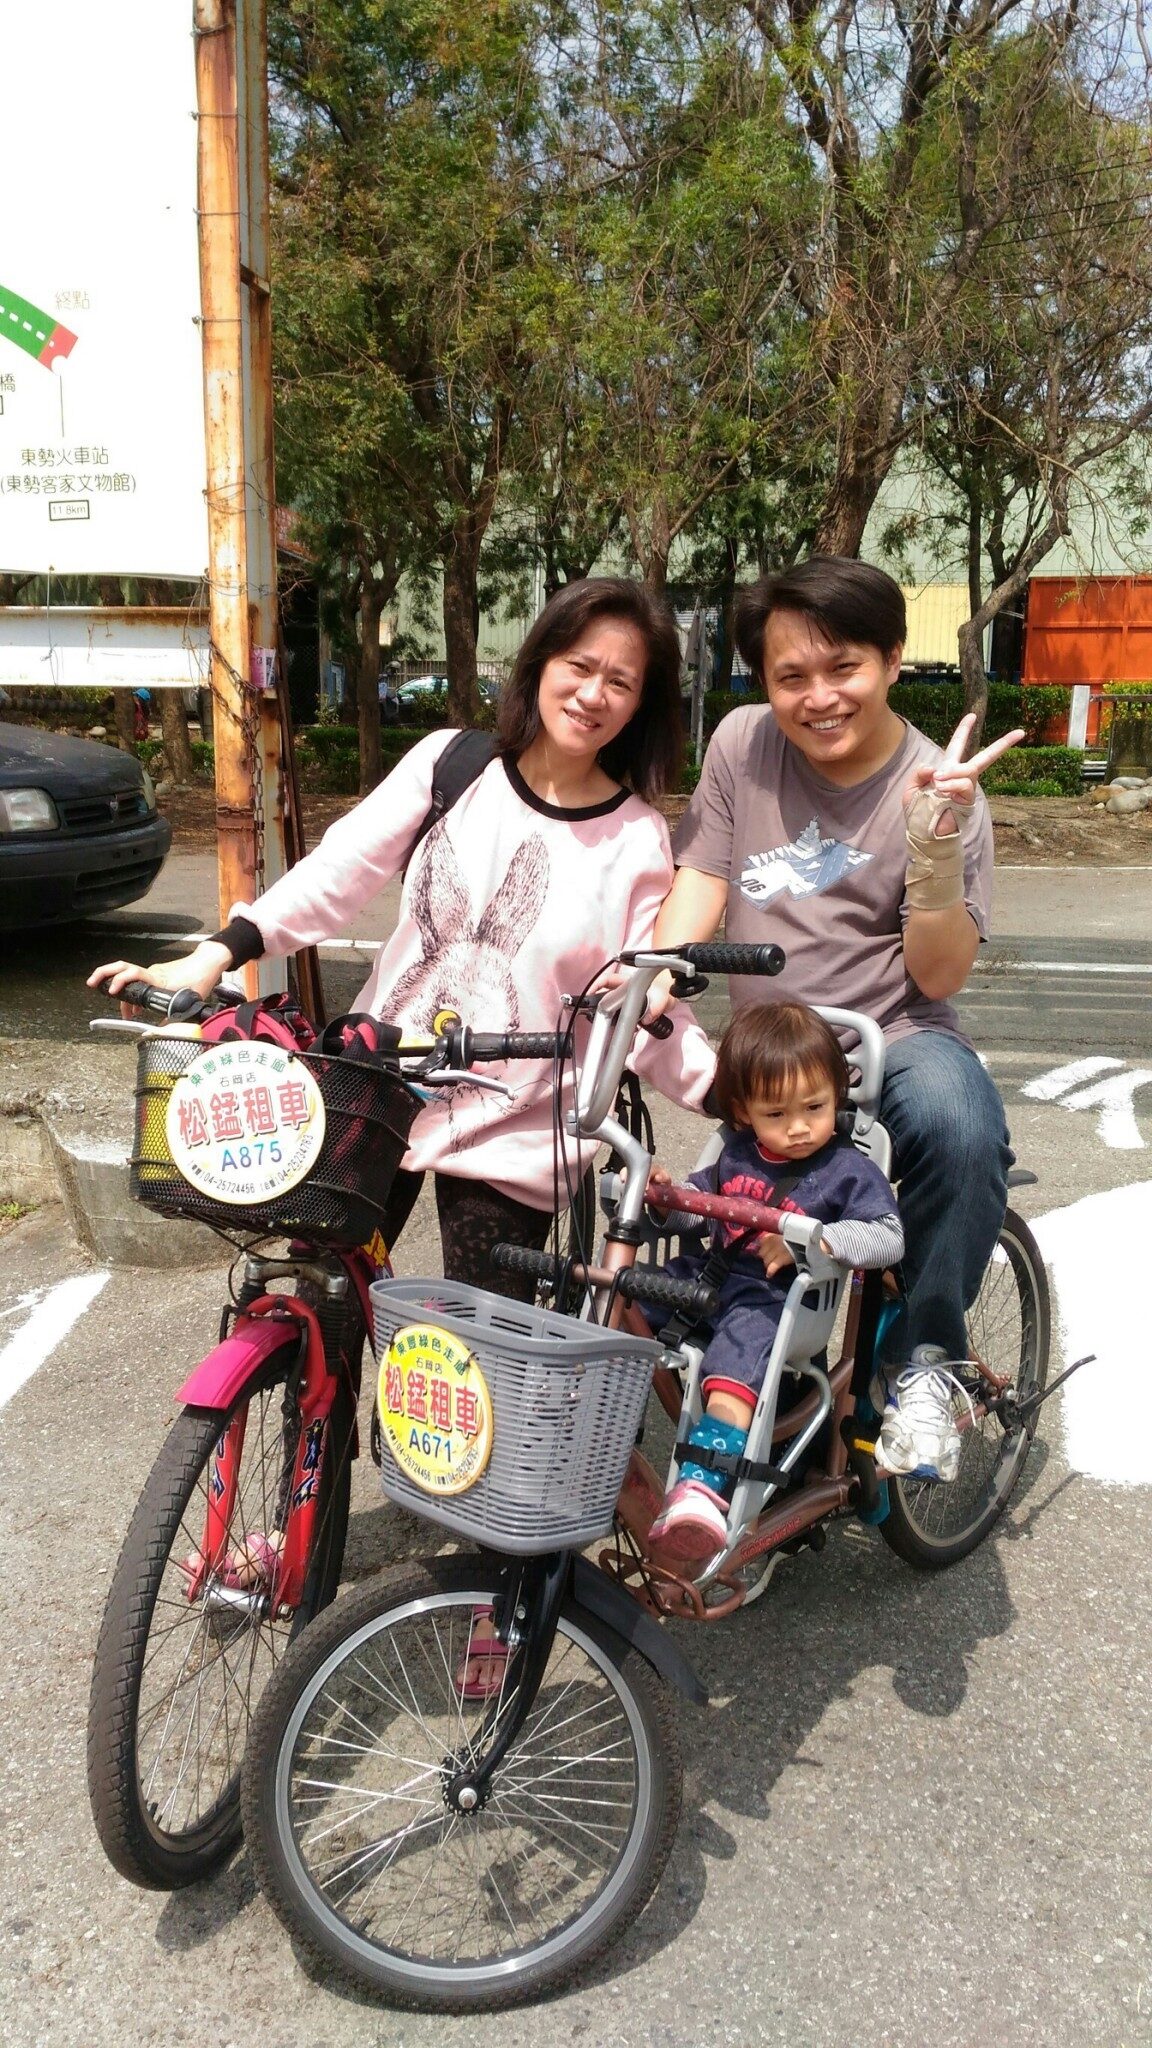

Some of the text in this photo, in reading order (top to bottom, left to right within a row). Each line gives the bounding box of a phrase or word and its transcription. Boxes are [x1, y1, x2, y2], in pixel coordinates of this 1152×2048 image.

[56, 290, 90, 310] 終點
[21, 446, 109, 467] 東勢火車站
[1, 473, 137, 495] (東勢客家文物館)
[177, 1080, 310, 1149] 松錳租車
[221, 1141, 282, 1171] A875
[385, 1367, 477, 1440] 松錳租車
[409, 1428, 451, 1462] A671
